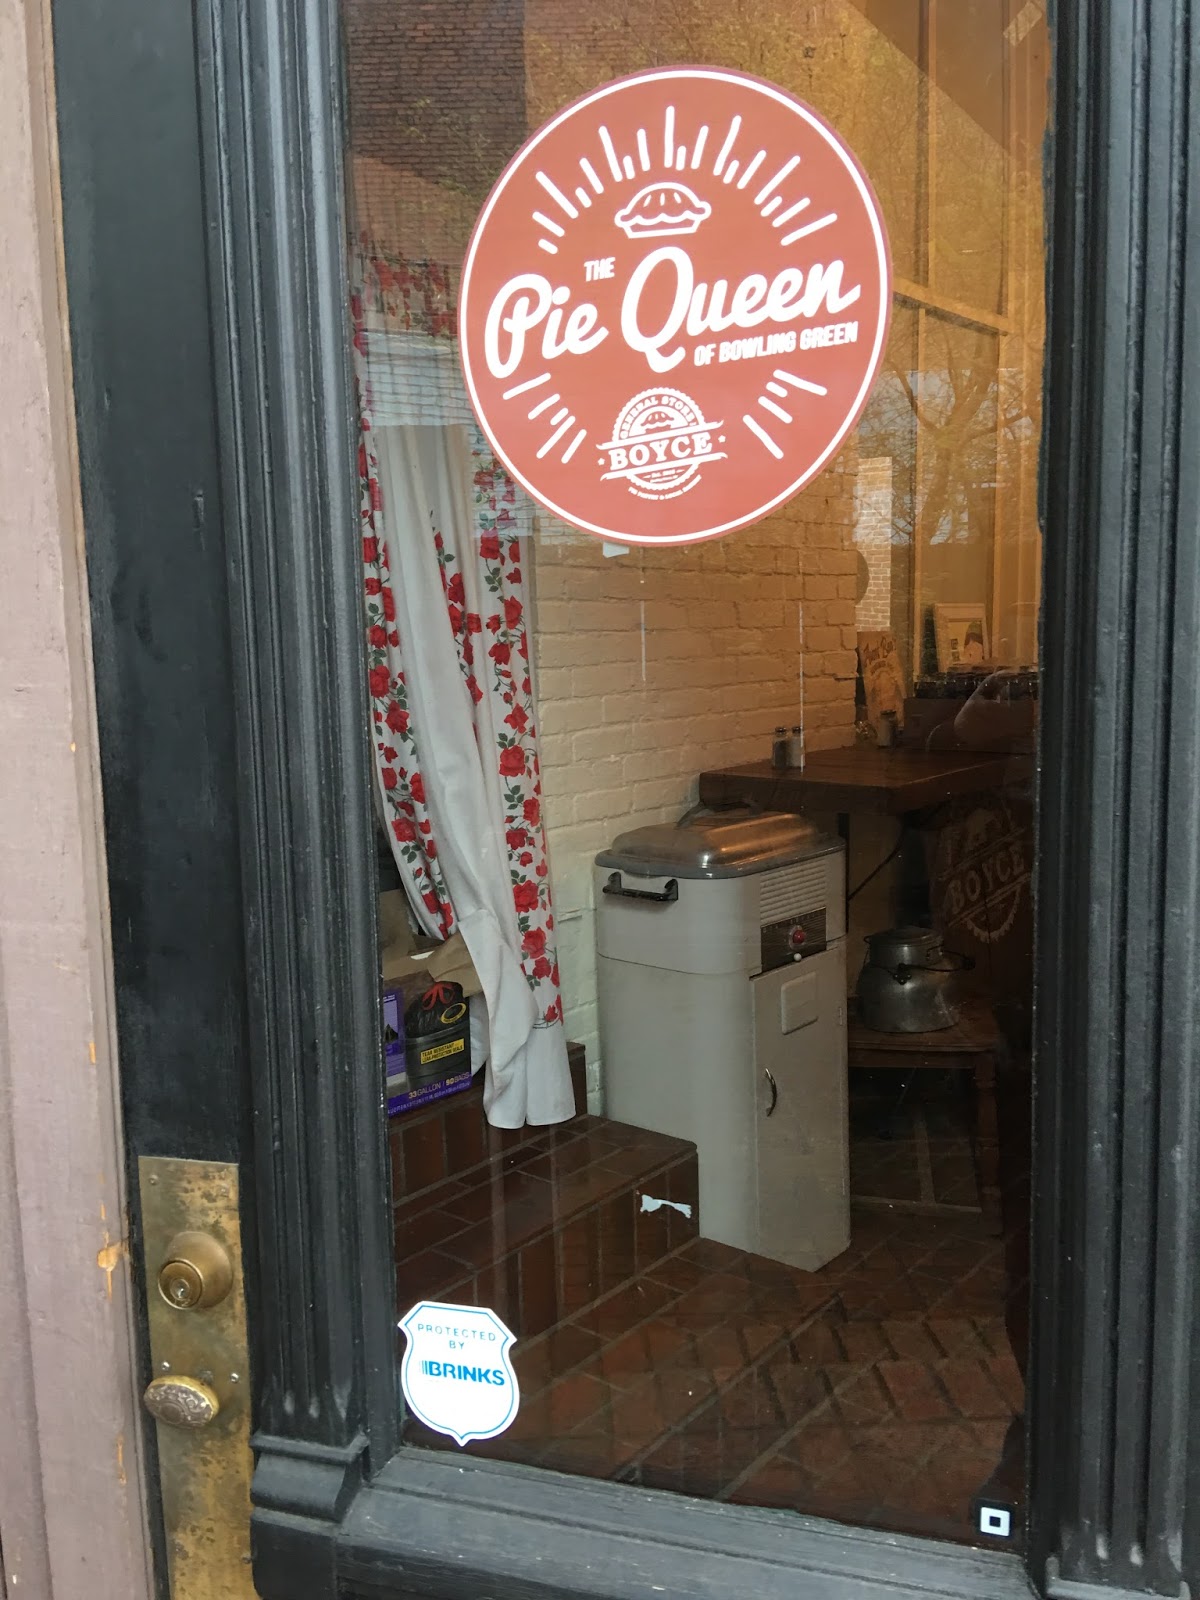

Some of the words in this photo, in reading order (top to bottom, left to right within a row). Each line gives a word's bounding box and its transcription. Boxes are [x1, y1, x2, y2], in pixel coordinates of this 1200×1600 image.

[584, 257, 615, 282] THE
[485, 273, 609, 378] Pie
[620, 246, 861, 373] Queen
[694, 344, 715, 366] OF
[719, 331, 796, 362] BOWLING
[800, 321, 858, 351] GREEN
[620, 396, 659, 439] GENERAL
[608, 432, 713, 470] BOYCE
[417, 1323, 497, 1342] PROTECTED
[449, 1340, 465, 1350] BY
[428, 1360, 505, 1386] BRINKS
